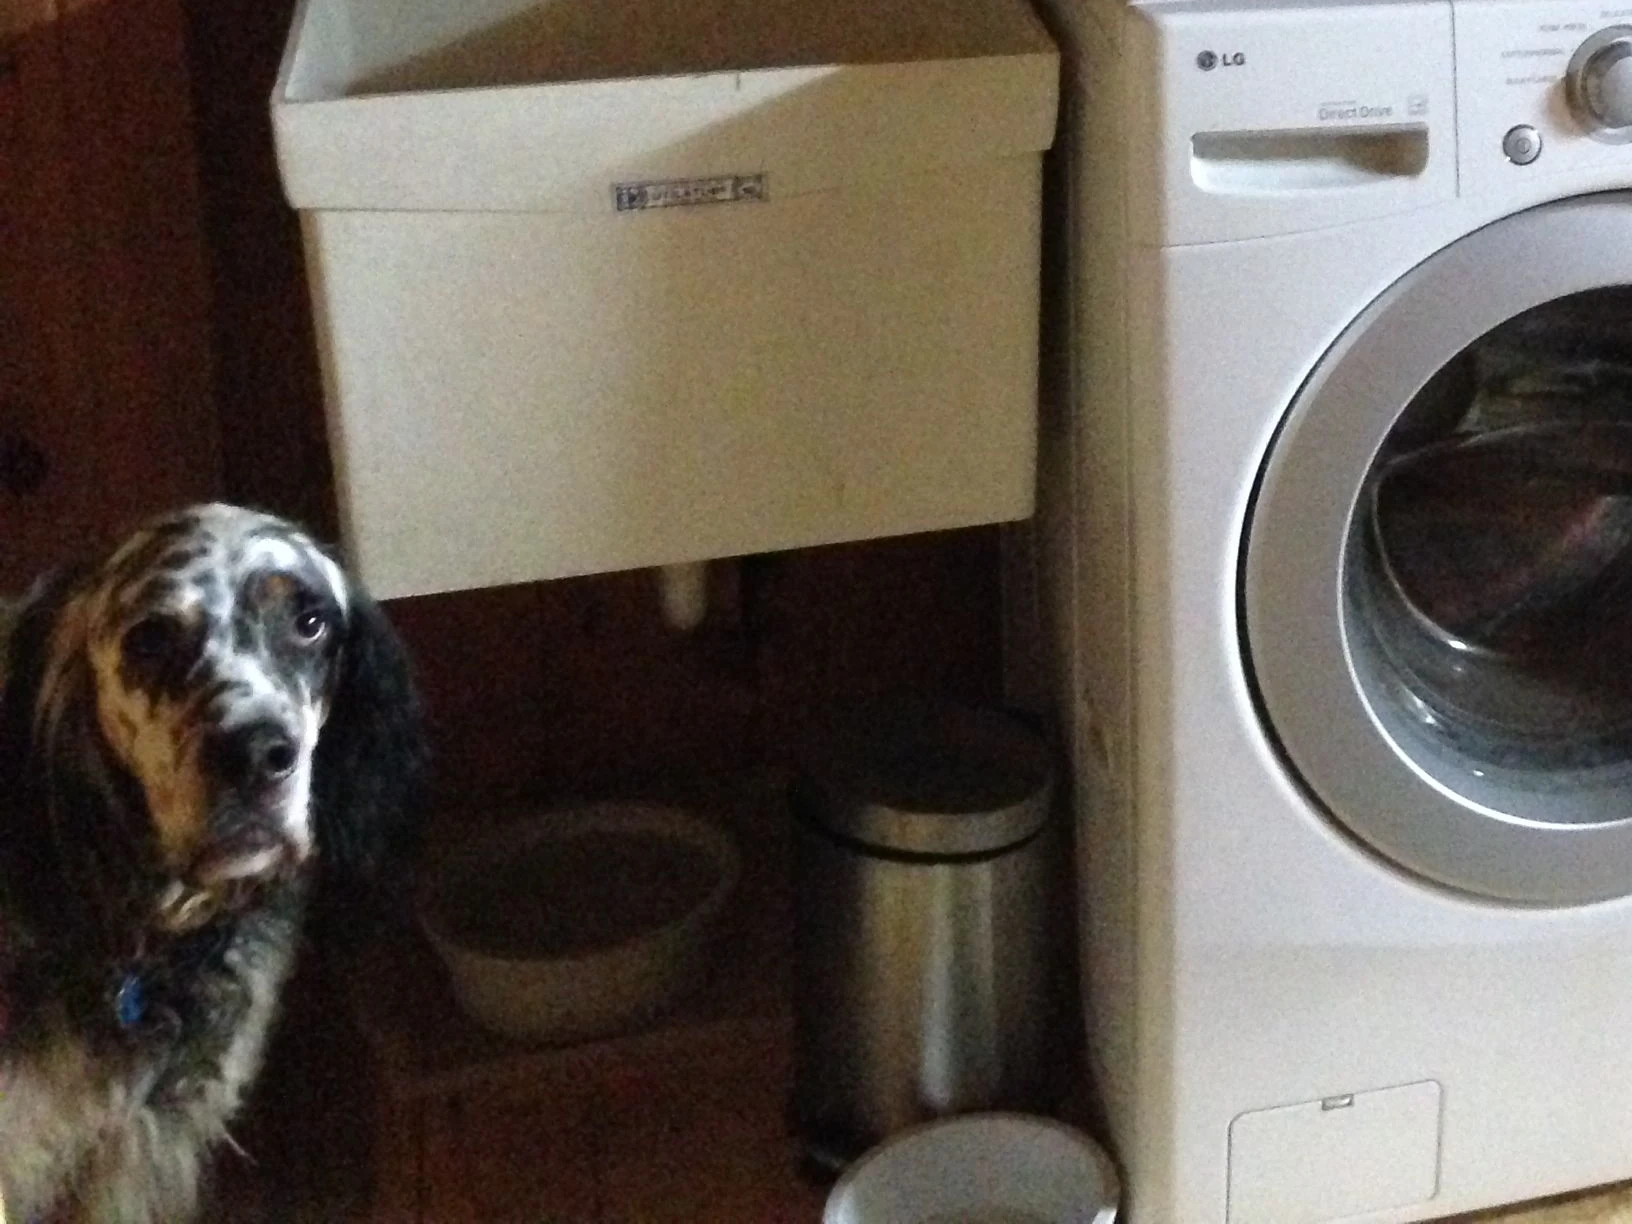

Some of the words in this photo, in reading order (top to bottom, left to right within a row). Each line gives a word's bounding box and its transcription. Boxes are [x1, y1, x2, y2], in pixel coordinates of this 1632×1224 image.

[1222, 52, 1246, 66] LG
[1318, 107, 1357, 121] Direct
[1360, 105, 1393, 118] Drive
